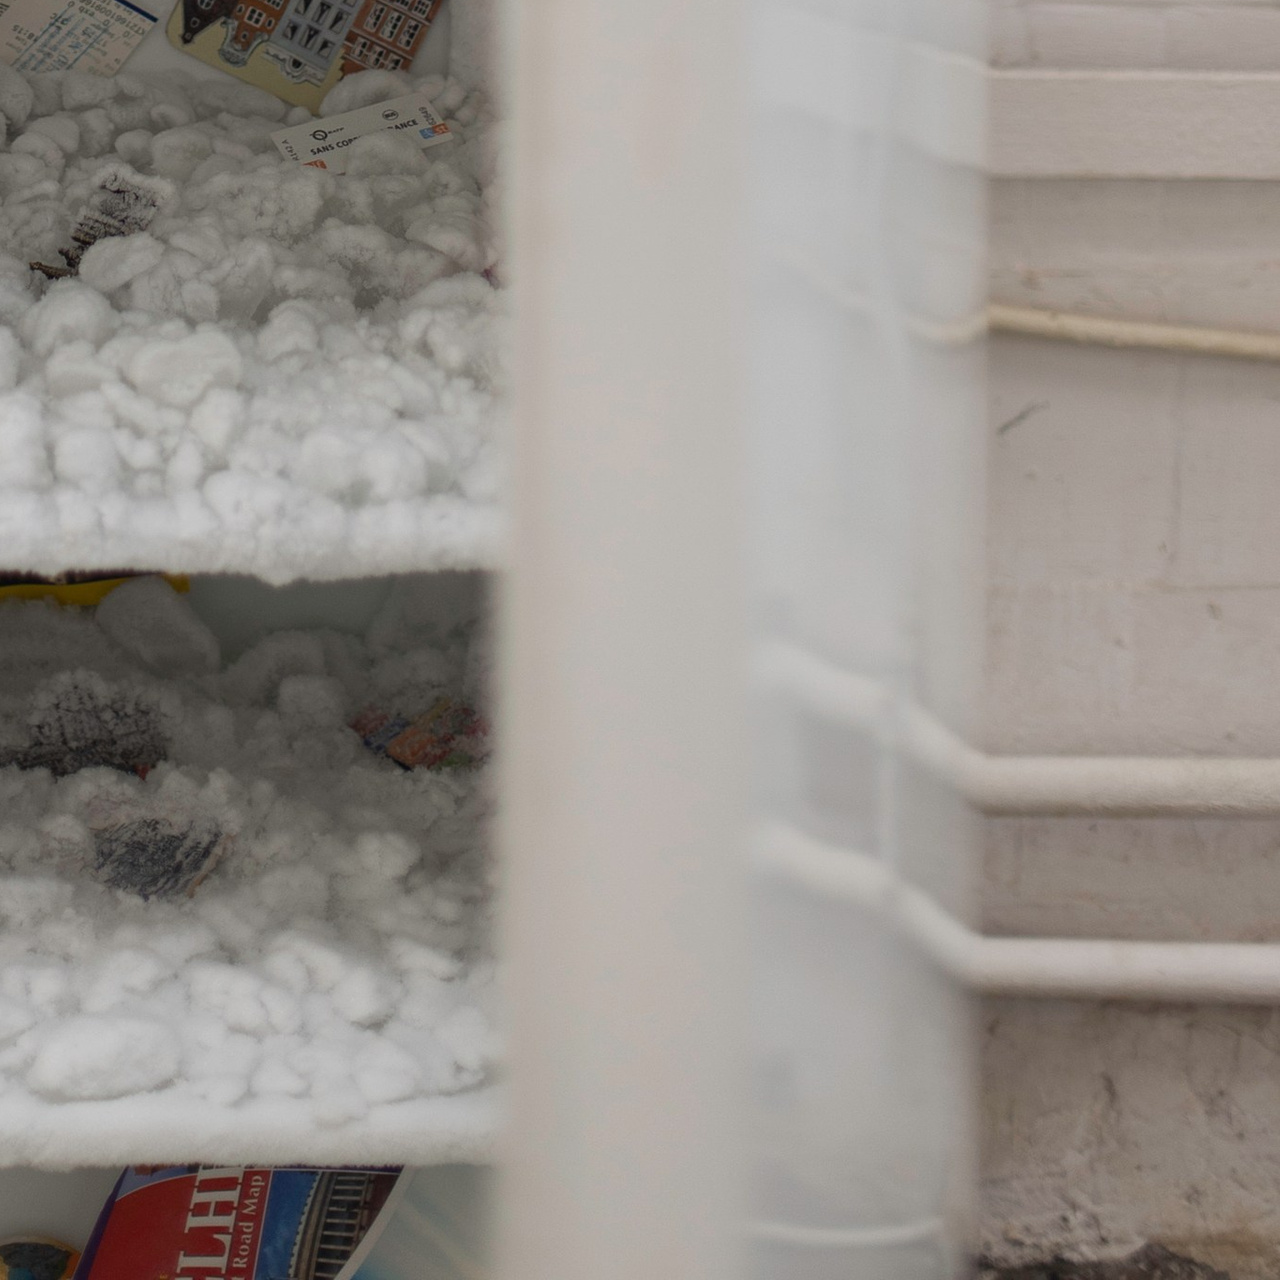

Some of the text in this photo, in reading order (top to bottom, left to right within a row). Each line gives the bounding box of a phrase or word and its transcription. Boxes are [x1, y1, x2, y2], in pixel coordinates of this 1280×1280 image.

[310, 145, 335, 156] SANS
[241, 1174, 266, 1216] Map
[232, 1221, 254, 1268] Road
